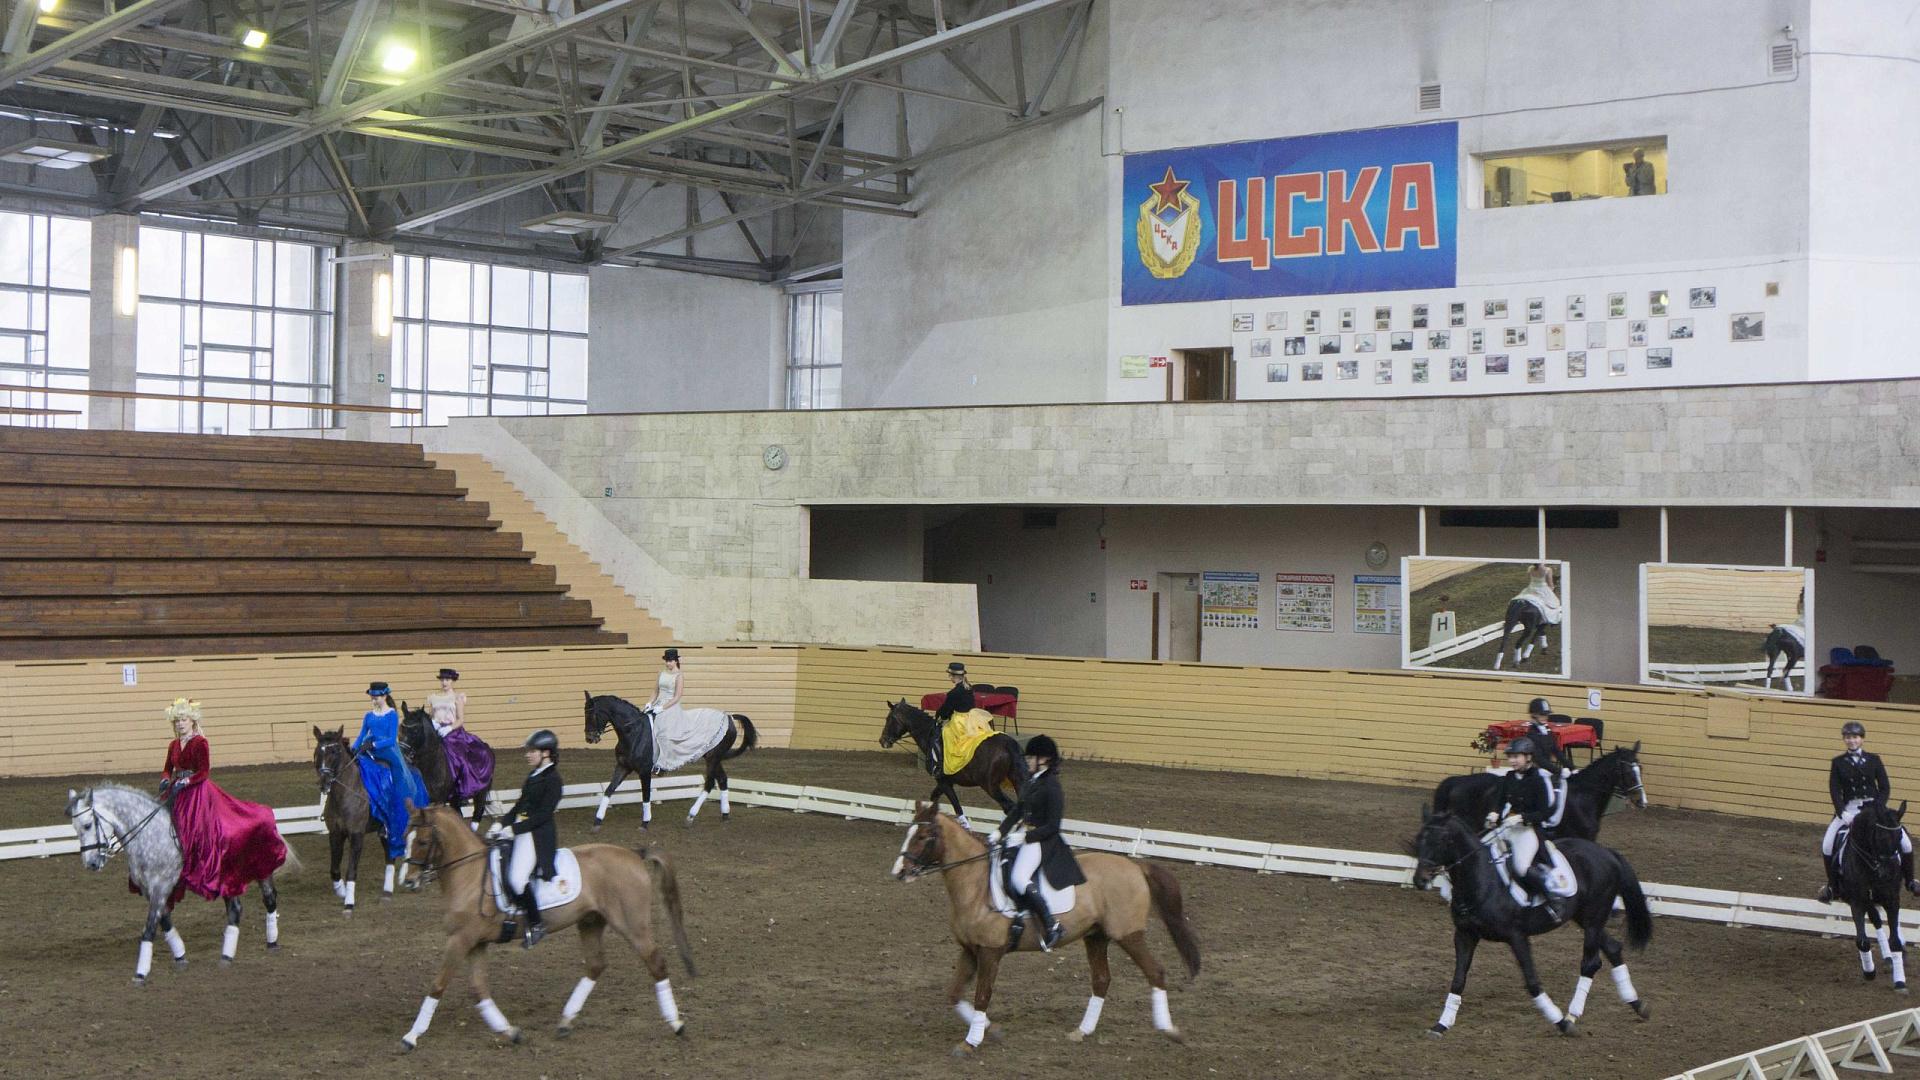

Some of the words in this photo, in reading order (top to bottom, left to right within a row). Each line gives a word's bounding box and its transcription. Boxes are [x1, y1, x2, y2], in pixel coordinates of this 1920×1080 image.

[1217, 162, 1439, 271] ЦСКА
[1154, 223, 1178, 250] ЦСКА
[125, 669, 135, 682] H
[1589, 691, 1601, 707] C
